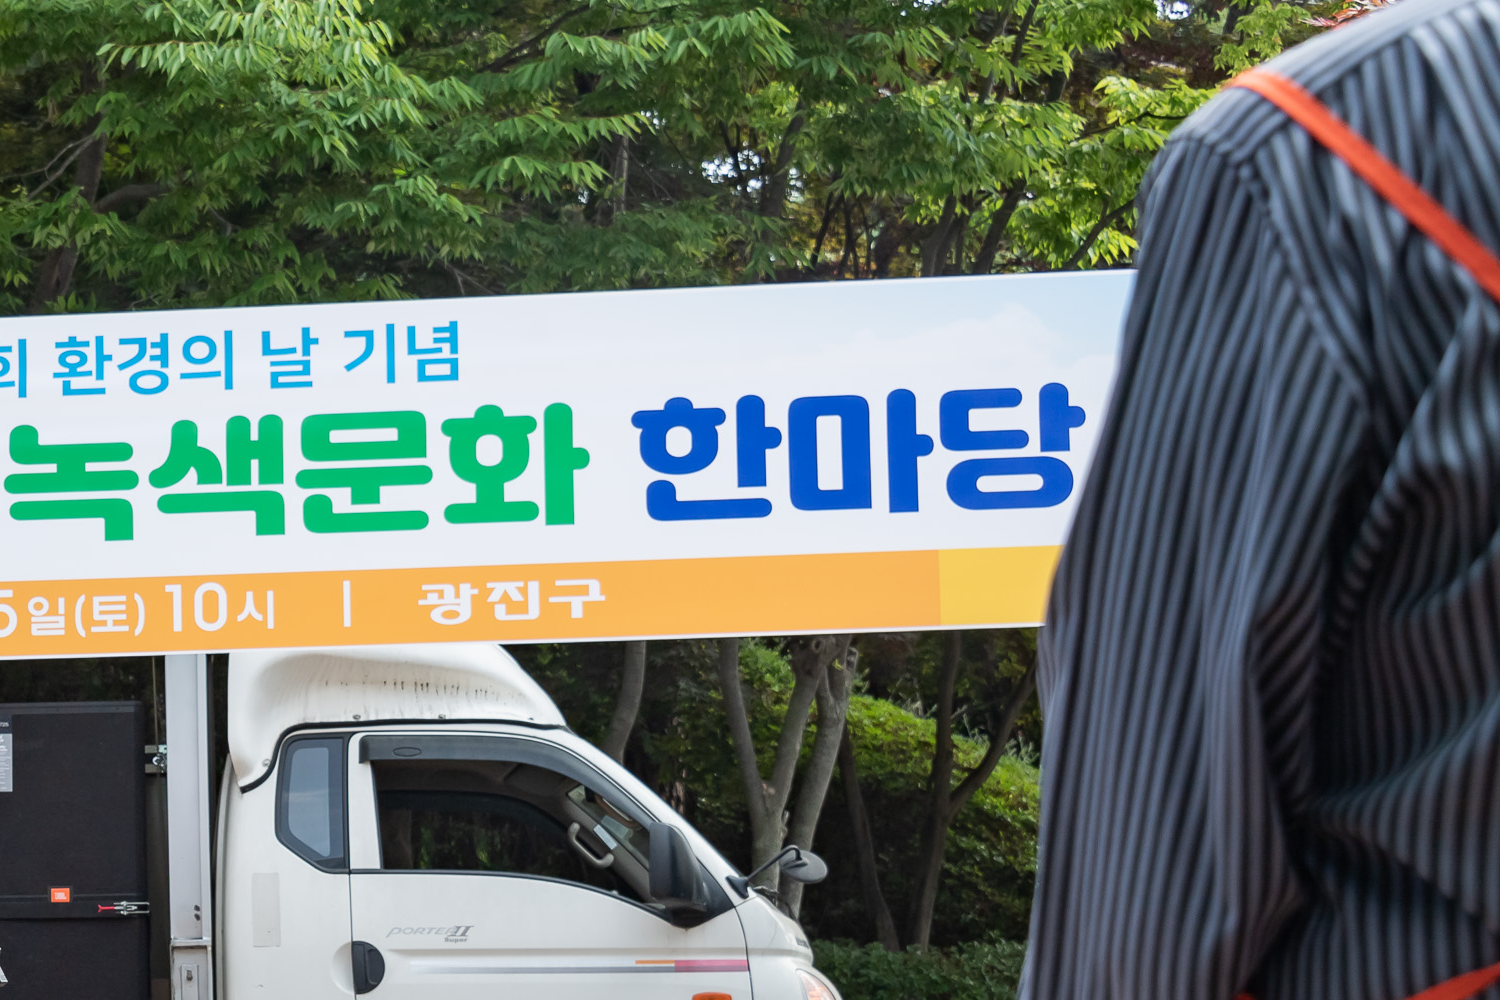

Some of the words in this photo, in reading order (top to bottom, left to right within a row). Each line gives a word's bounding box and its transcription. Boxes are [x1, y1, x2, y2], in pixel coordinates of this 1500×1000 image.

[52, 329, 234, 397] 환경의
[260, 326, 320, 390] 날
[343, 320, 460, 385] 기념
[3, 402, 590, 542] 녹색문화
[631, 382, 1086, 522] 한마당
[164, 581, 275, 633] 10시
[417, 578, 607, 626] 광진구
